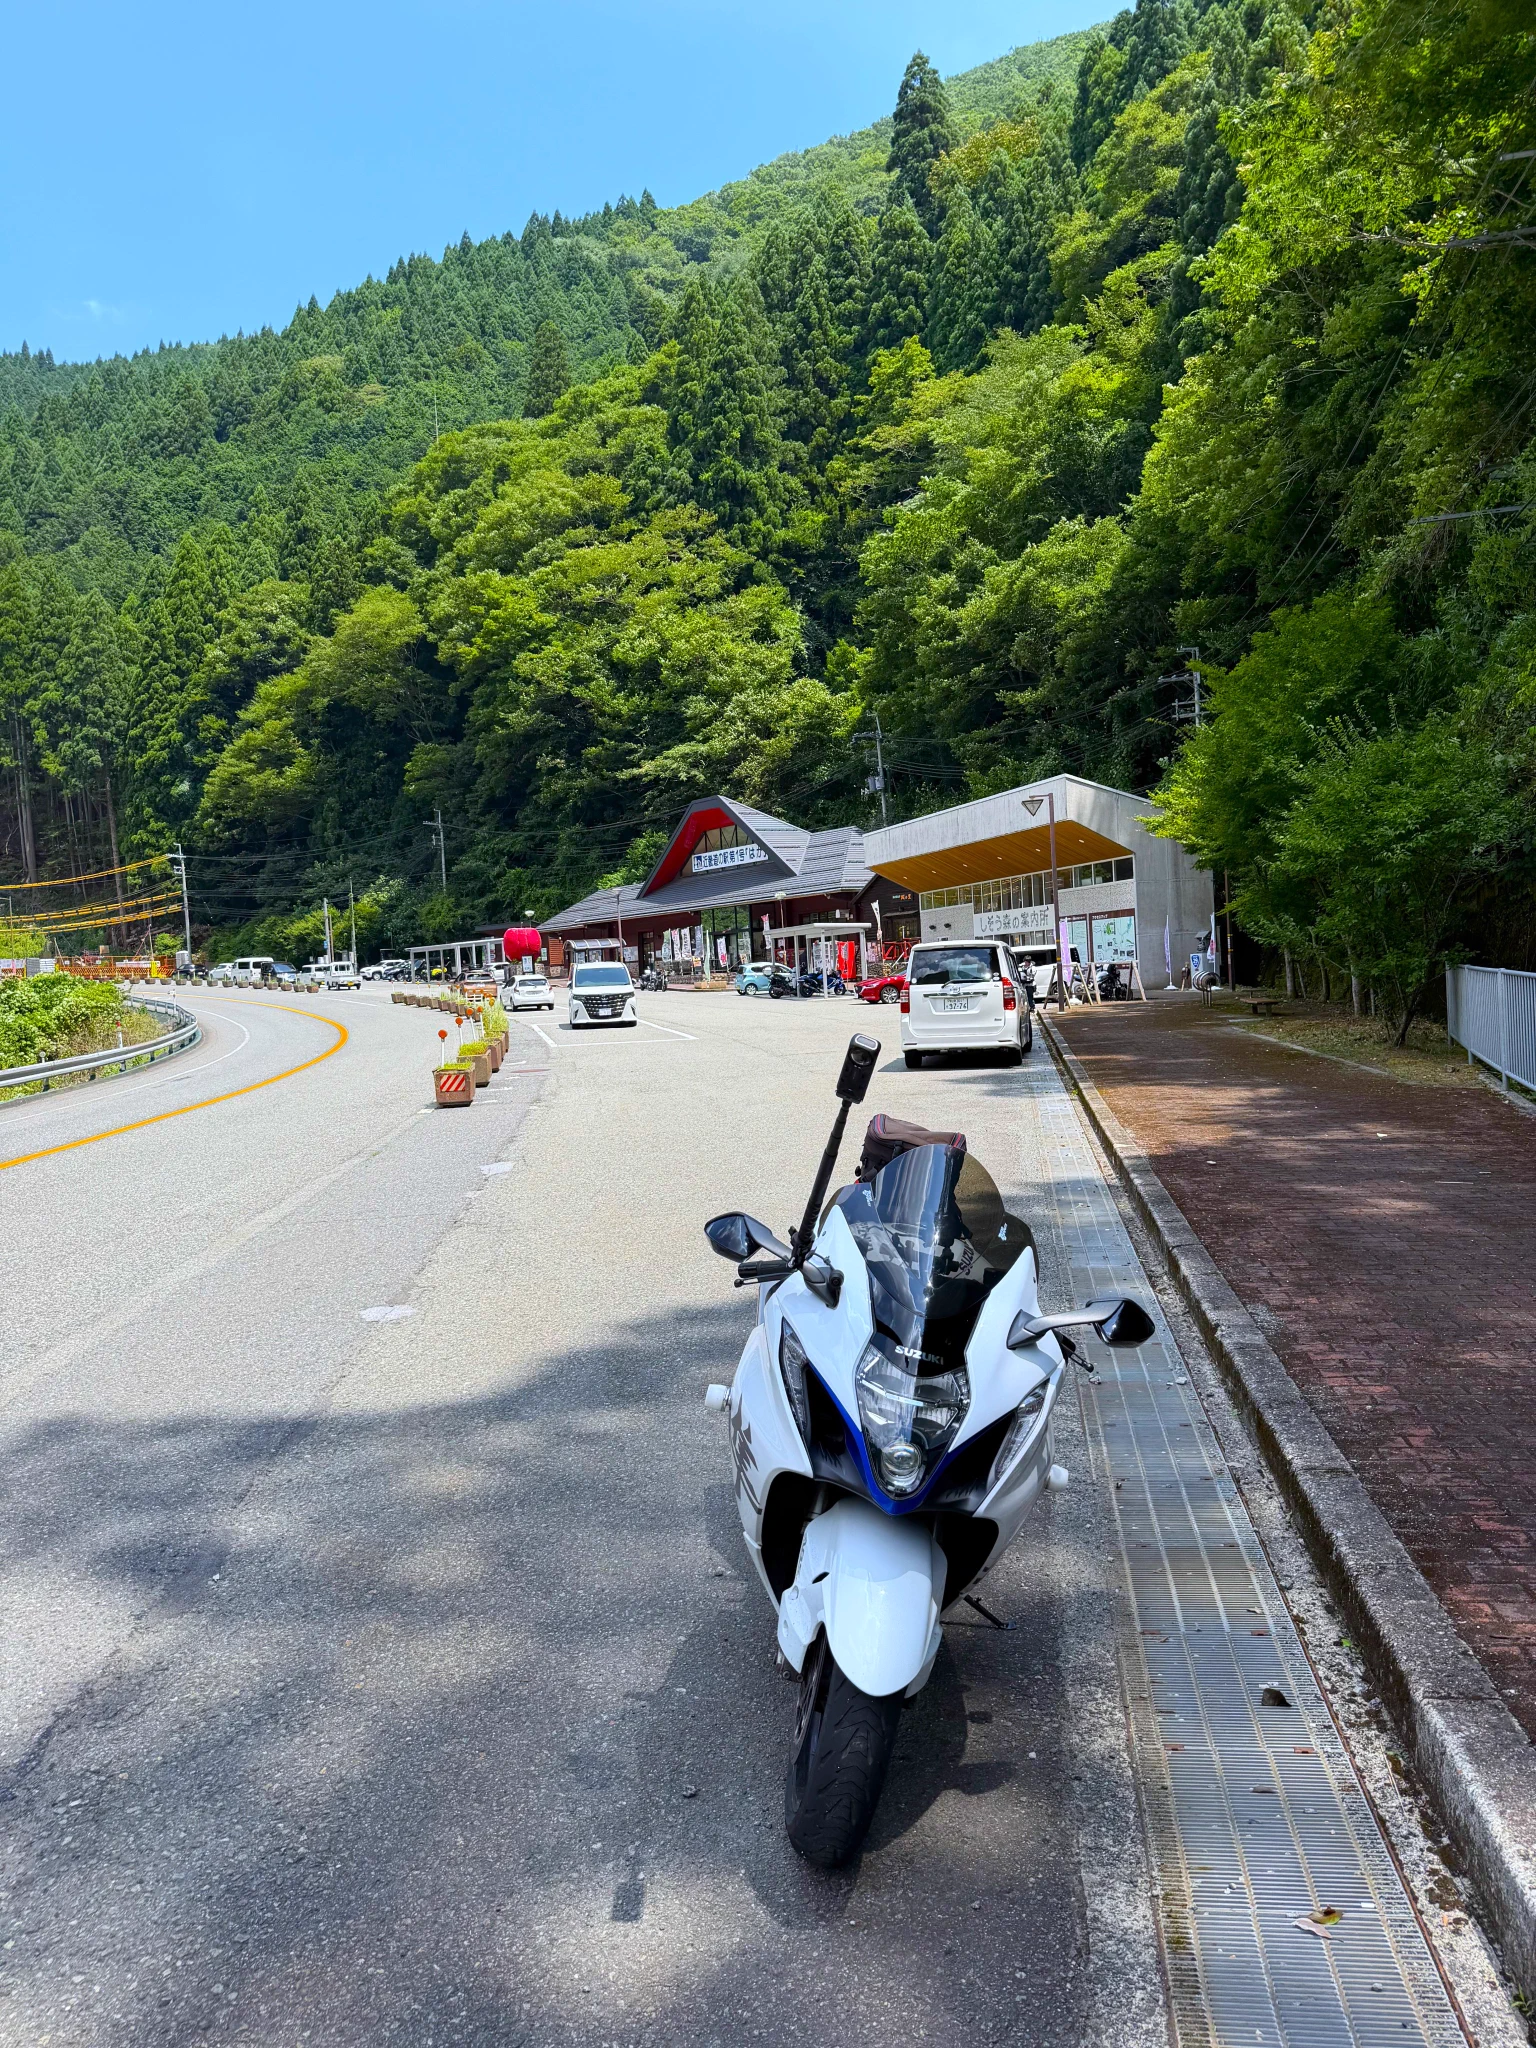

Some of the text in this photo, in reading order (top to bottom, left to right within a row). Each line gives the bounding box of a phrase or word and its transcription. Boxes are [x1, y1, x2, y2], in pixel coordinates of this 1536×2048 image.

[980, 905, 1049, 932] しそう森の案内所
[895, 1345, 944, 1365] SUZUKI
